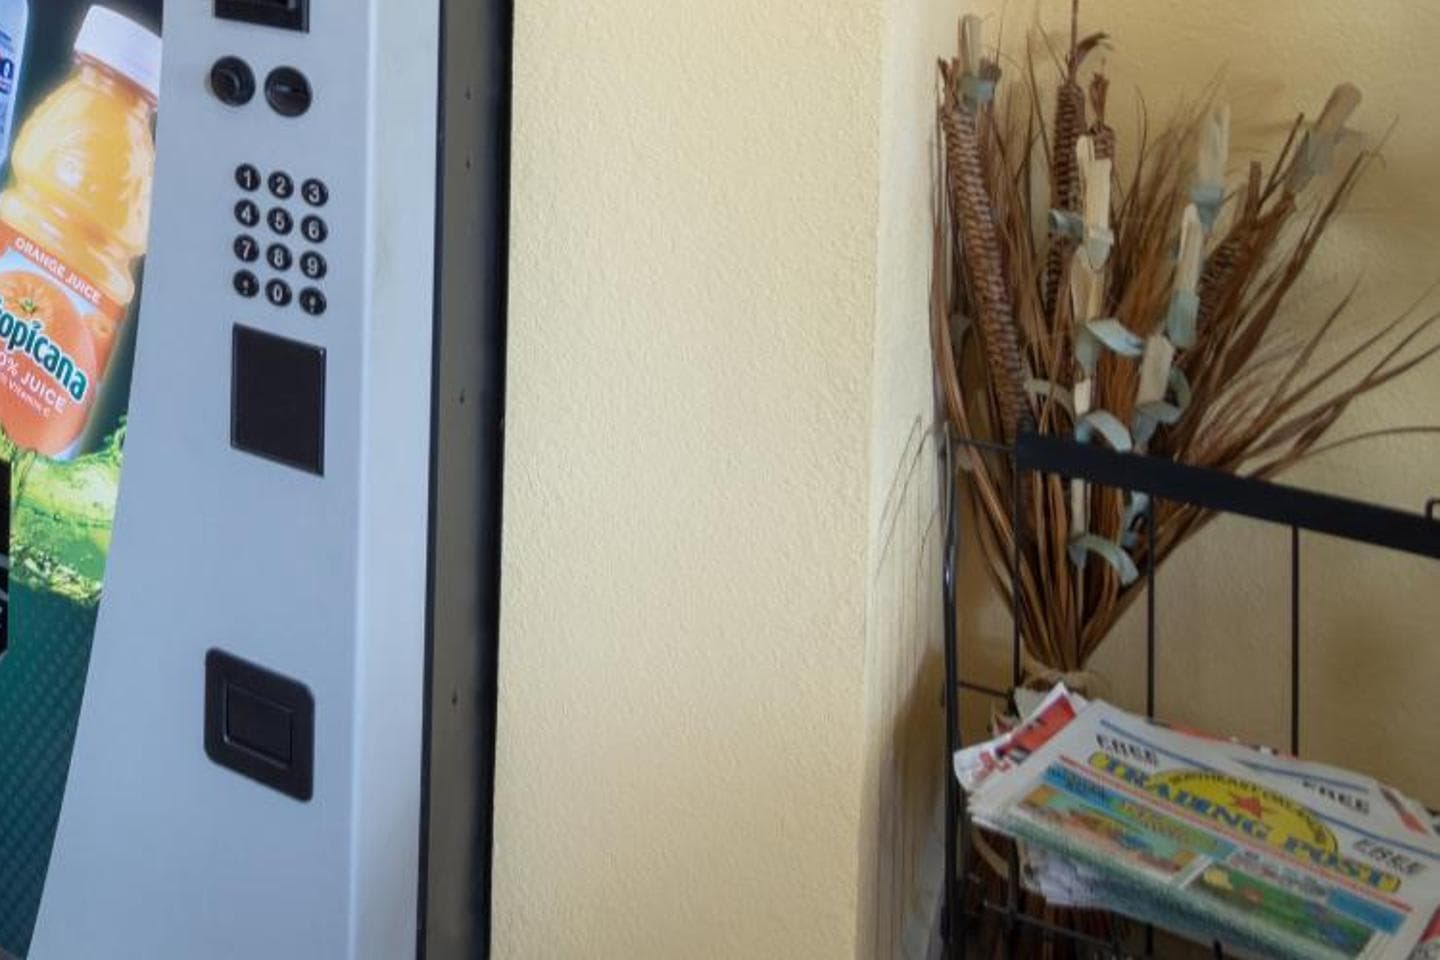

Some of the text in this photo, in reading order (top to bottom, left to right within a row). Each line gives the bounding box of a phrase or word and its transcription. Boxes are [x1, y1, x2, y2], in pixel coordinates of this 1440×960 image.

[244, 170, 320, 203] 1 2 3
[241, 205, 320, 239] 4 5 6
[14, 236, 102, 304] ORANGE JUICE
[242, 241, 318, 274] 7 8 9
[20, 370, 68, 414] JUICE
[1096, 733, 1158, 767] FREE
